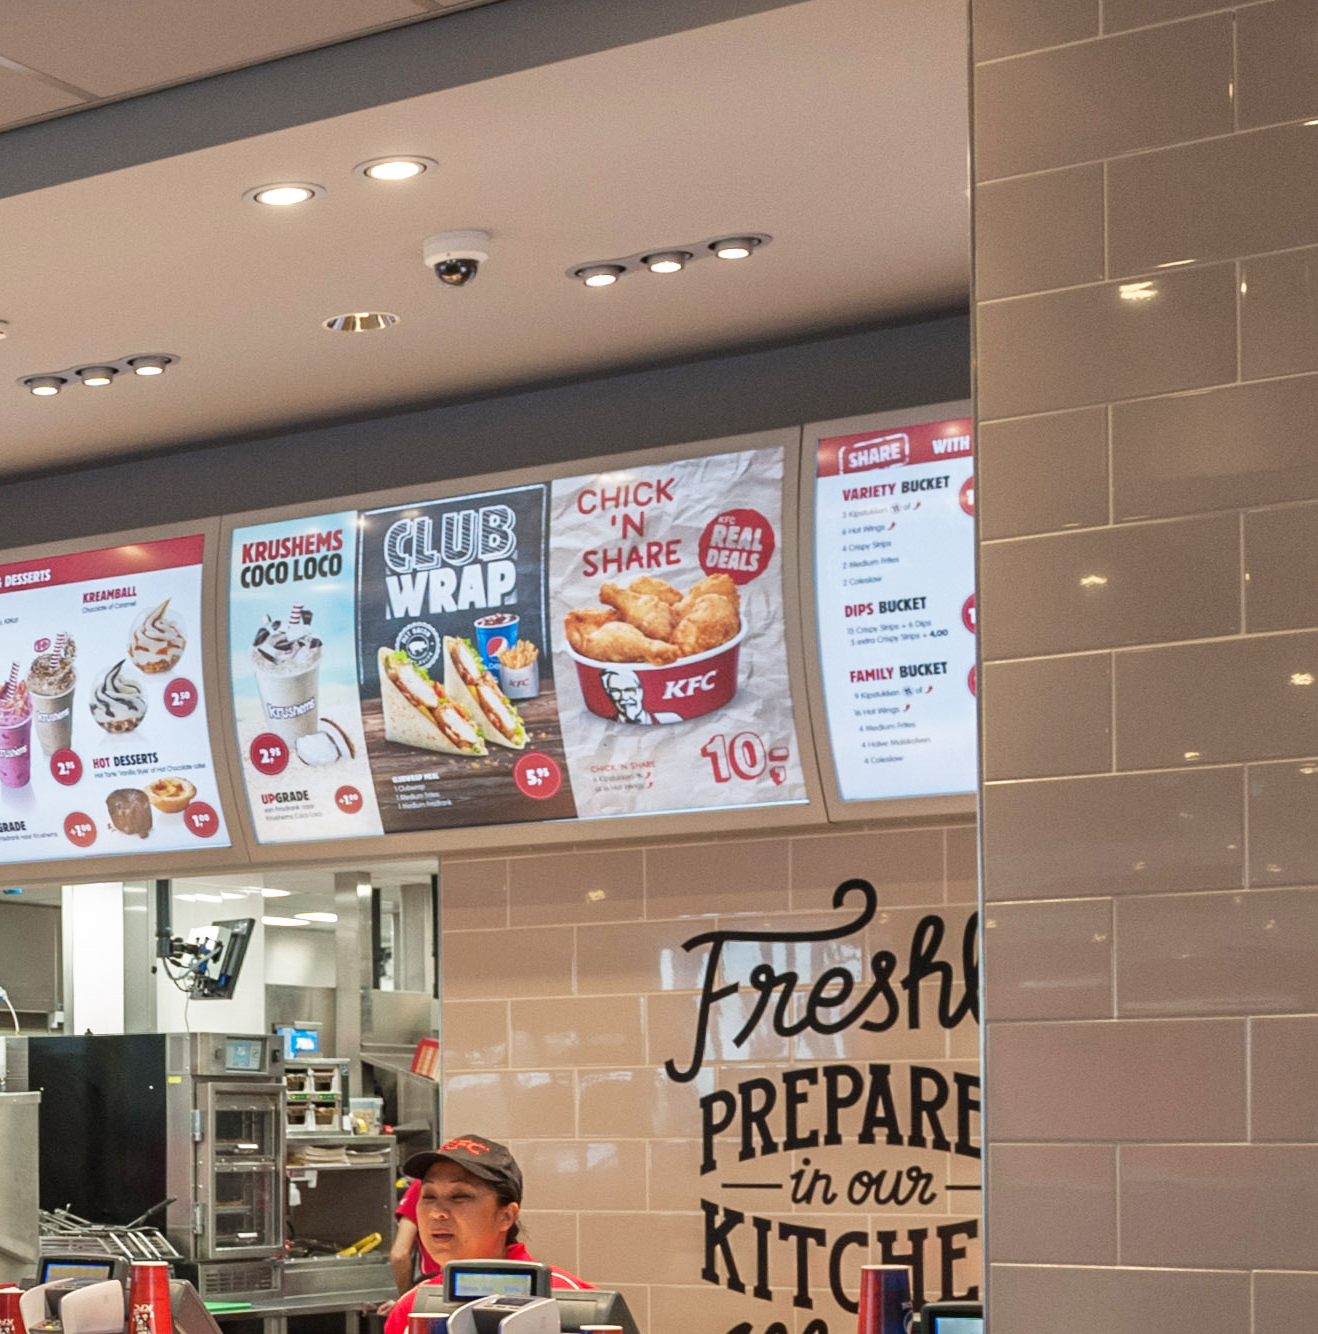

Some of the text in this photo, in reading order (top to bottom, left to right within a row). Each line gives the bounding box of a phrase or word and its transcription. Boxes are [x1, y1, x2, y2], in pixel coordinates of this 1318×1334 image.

[848, 435, 971, 468] SHARE WITH
[577, 477, 676, 515] CHICK
[842, 475, 950, 502] VARIETY BUCKET
[611, 511, 645, 540] 'N
[848, 524, 886, 535] Hot Wings
[242, 529, 343, 564] KRUSHEMS
[384, 504, 517, 574] CLUB
[710, 524, 763, 552] REAL
[848, 542, 871, 553] Crispy
[872, 540, 892, 549] Strips
[582, 539, 683, 577] SHARE
[705, 549, 760, 573] DEALS
[849, 558, 880, 568] Medium
[4, 569, 52, 588] DESSERTS
[241, 553, 342, 589] COCO LOCO
[849, 576, 882, 586] Coleslaw
[82, 586, 137, 604] KREAMBALL
[385, 560, 517, 619] WRAP
[844, 596, 927, 618] DIPS BUCKET
[856, 619, 932, 636] Crispy Strips Dips
[857, 629, 949, 646] extra Crispy Strips 4,00
[850, 661, 948, 683] FAMILY BUCKET
[662, 670, 718, 700] KFC
[861, 688, 900, 700] Kipstukken
[171, 690, 191, 707] 2,50
[862, 706, 900, 716] Hot Wings
[865, 722, 895, 732] Medium
[92, 752, 159, 769] HOT DESSERTS
[870, 754, 904, 764] Coleslaw
[525, 767, 551, 787] 5,95
[261, 790, 309, 805] UPGRADE
[790, 1157, 937, 1206] in our
